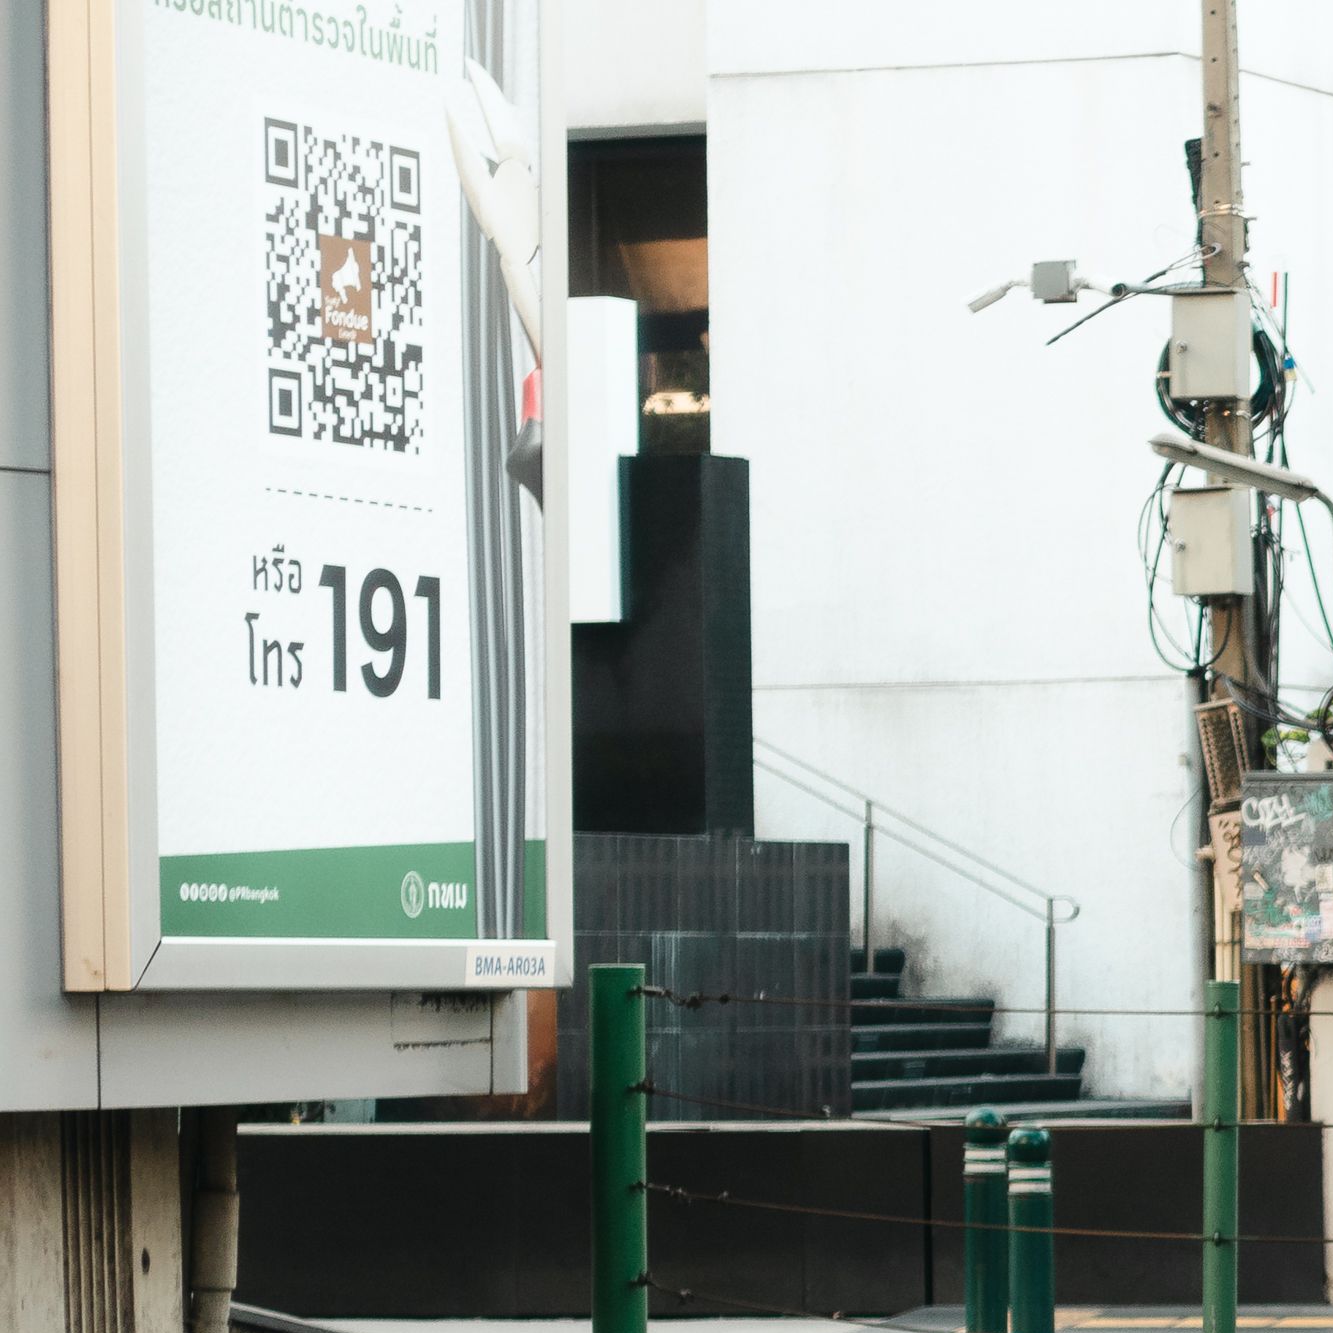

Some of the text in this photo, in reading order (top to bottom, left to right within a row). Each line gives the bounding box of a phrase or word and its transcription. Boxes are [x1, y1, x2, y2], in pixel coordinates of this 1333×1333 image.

[253, 544, 302, 594] หรือ
[245, 564, 441, 700] โทร 191
[428, 882, 468, 909] กทม
[475, 956, 546, 976] BMA-AR03A
